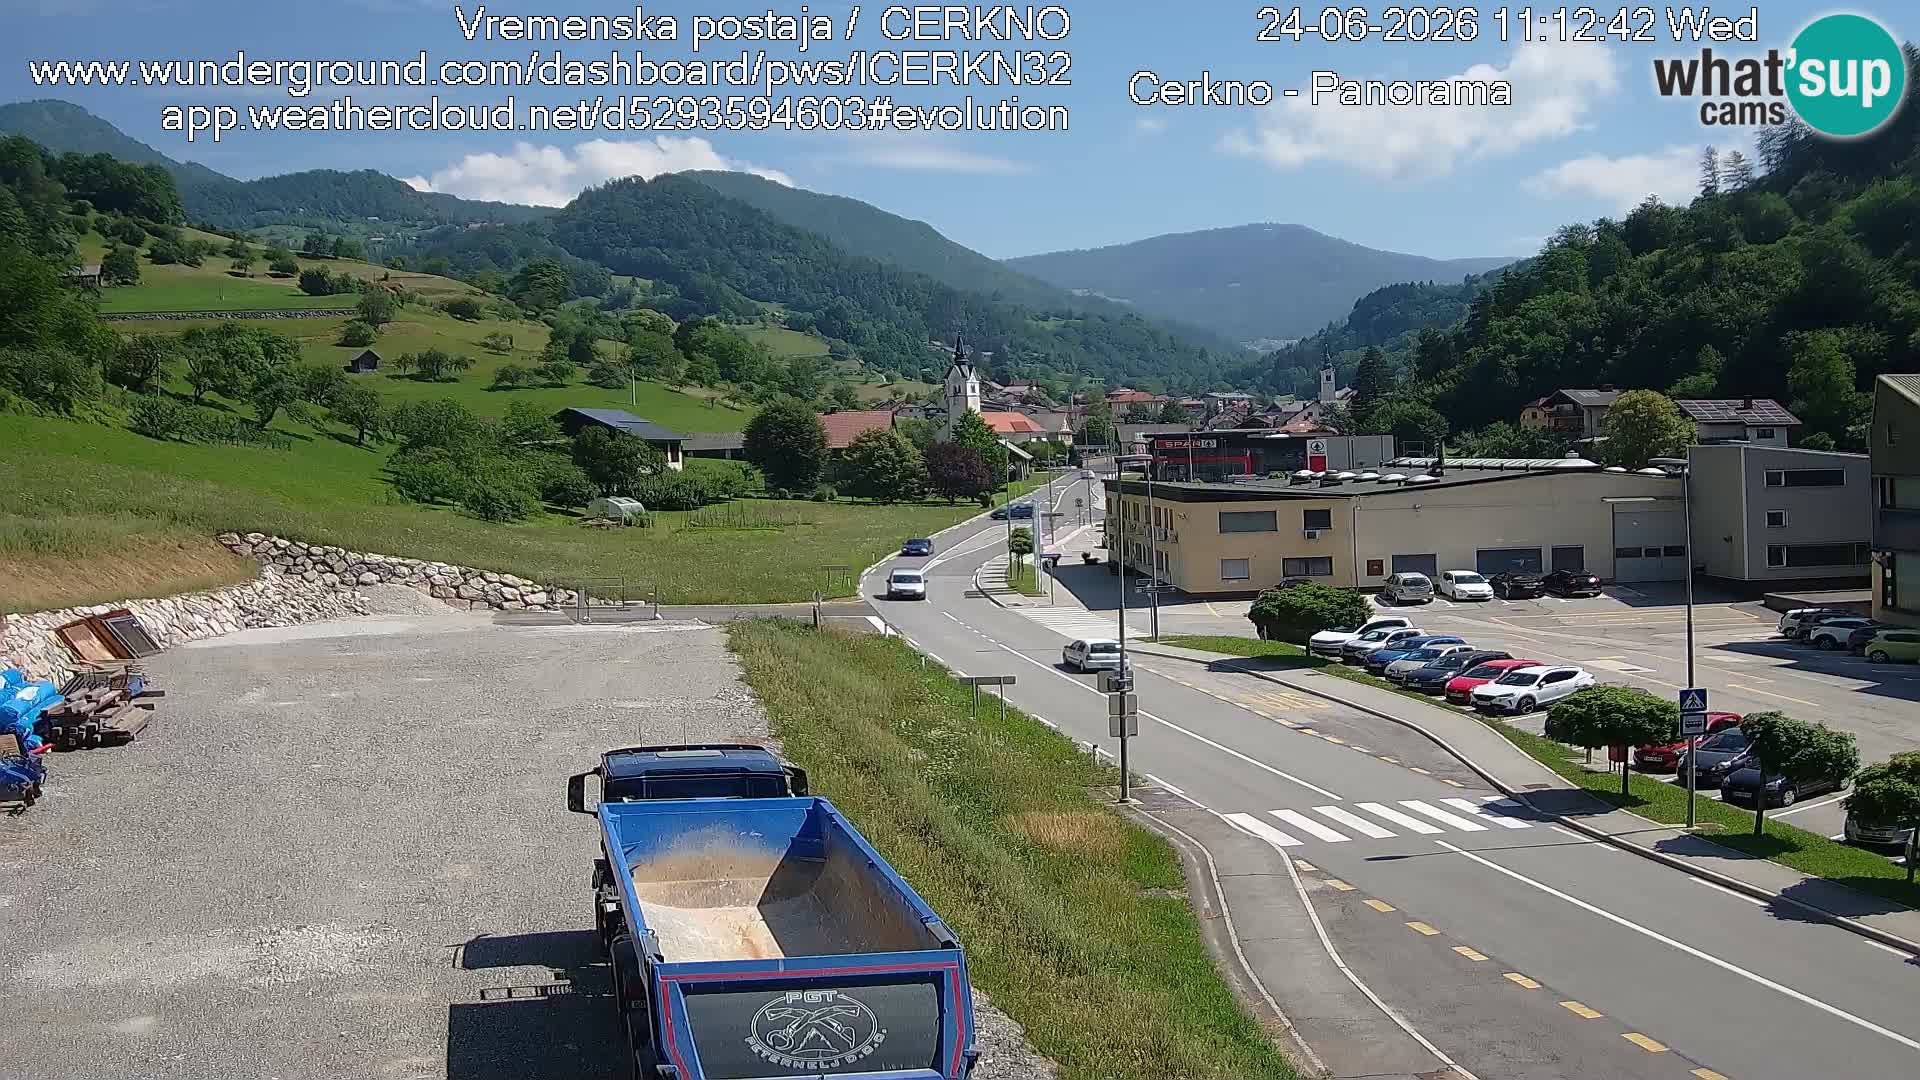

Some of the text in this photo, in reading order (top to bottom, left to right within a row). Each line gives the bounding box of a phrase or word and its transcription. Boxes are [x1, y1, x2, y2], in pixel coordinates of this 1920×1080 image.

[1165, 440, 1201, 448] SPAR
[785, 990, 838, 1004] PGT
[744, 1036, 840, 1069] PETERNELJ
